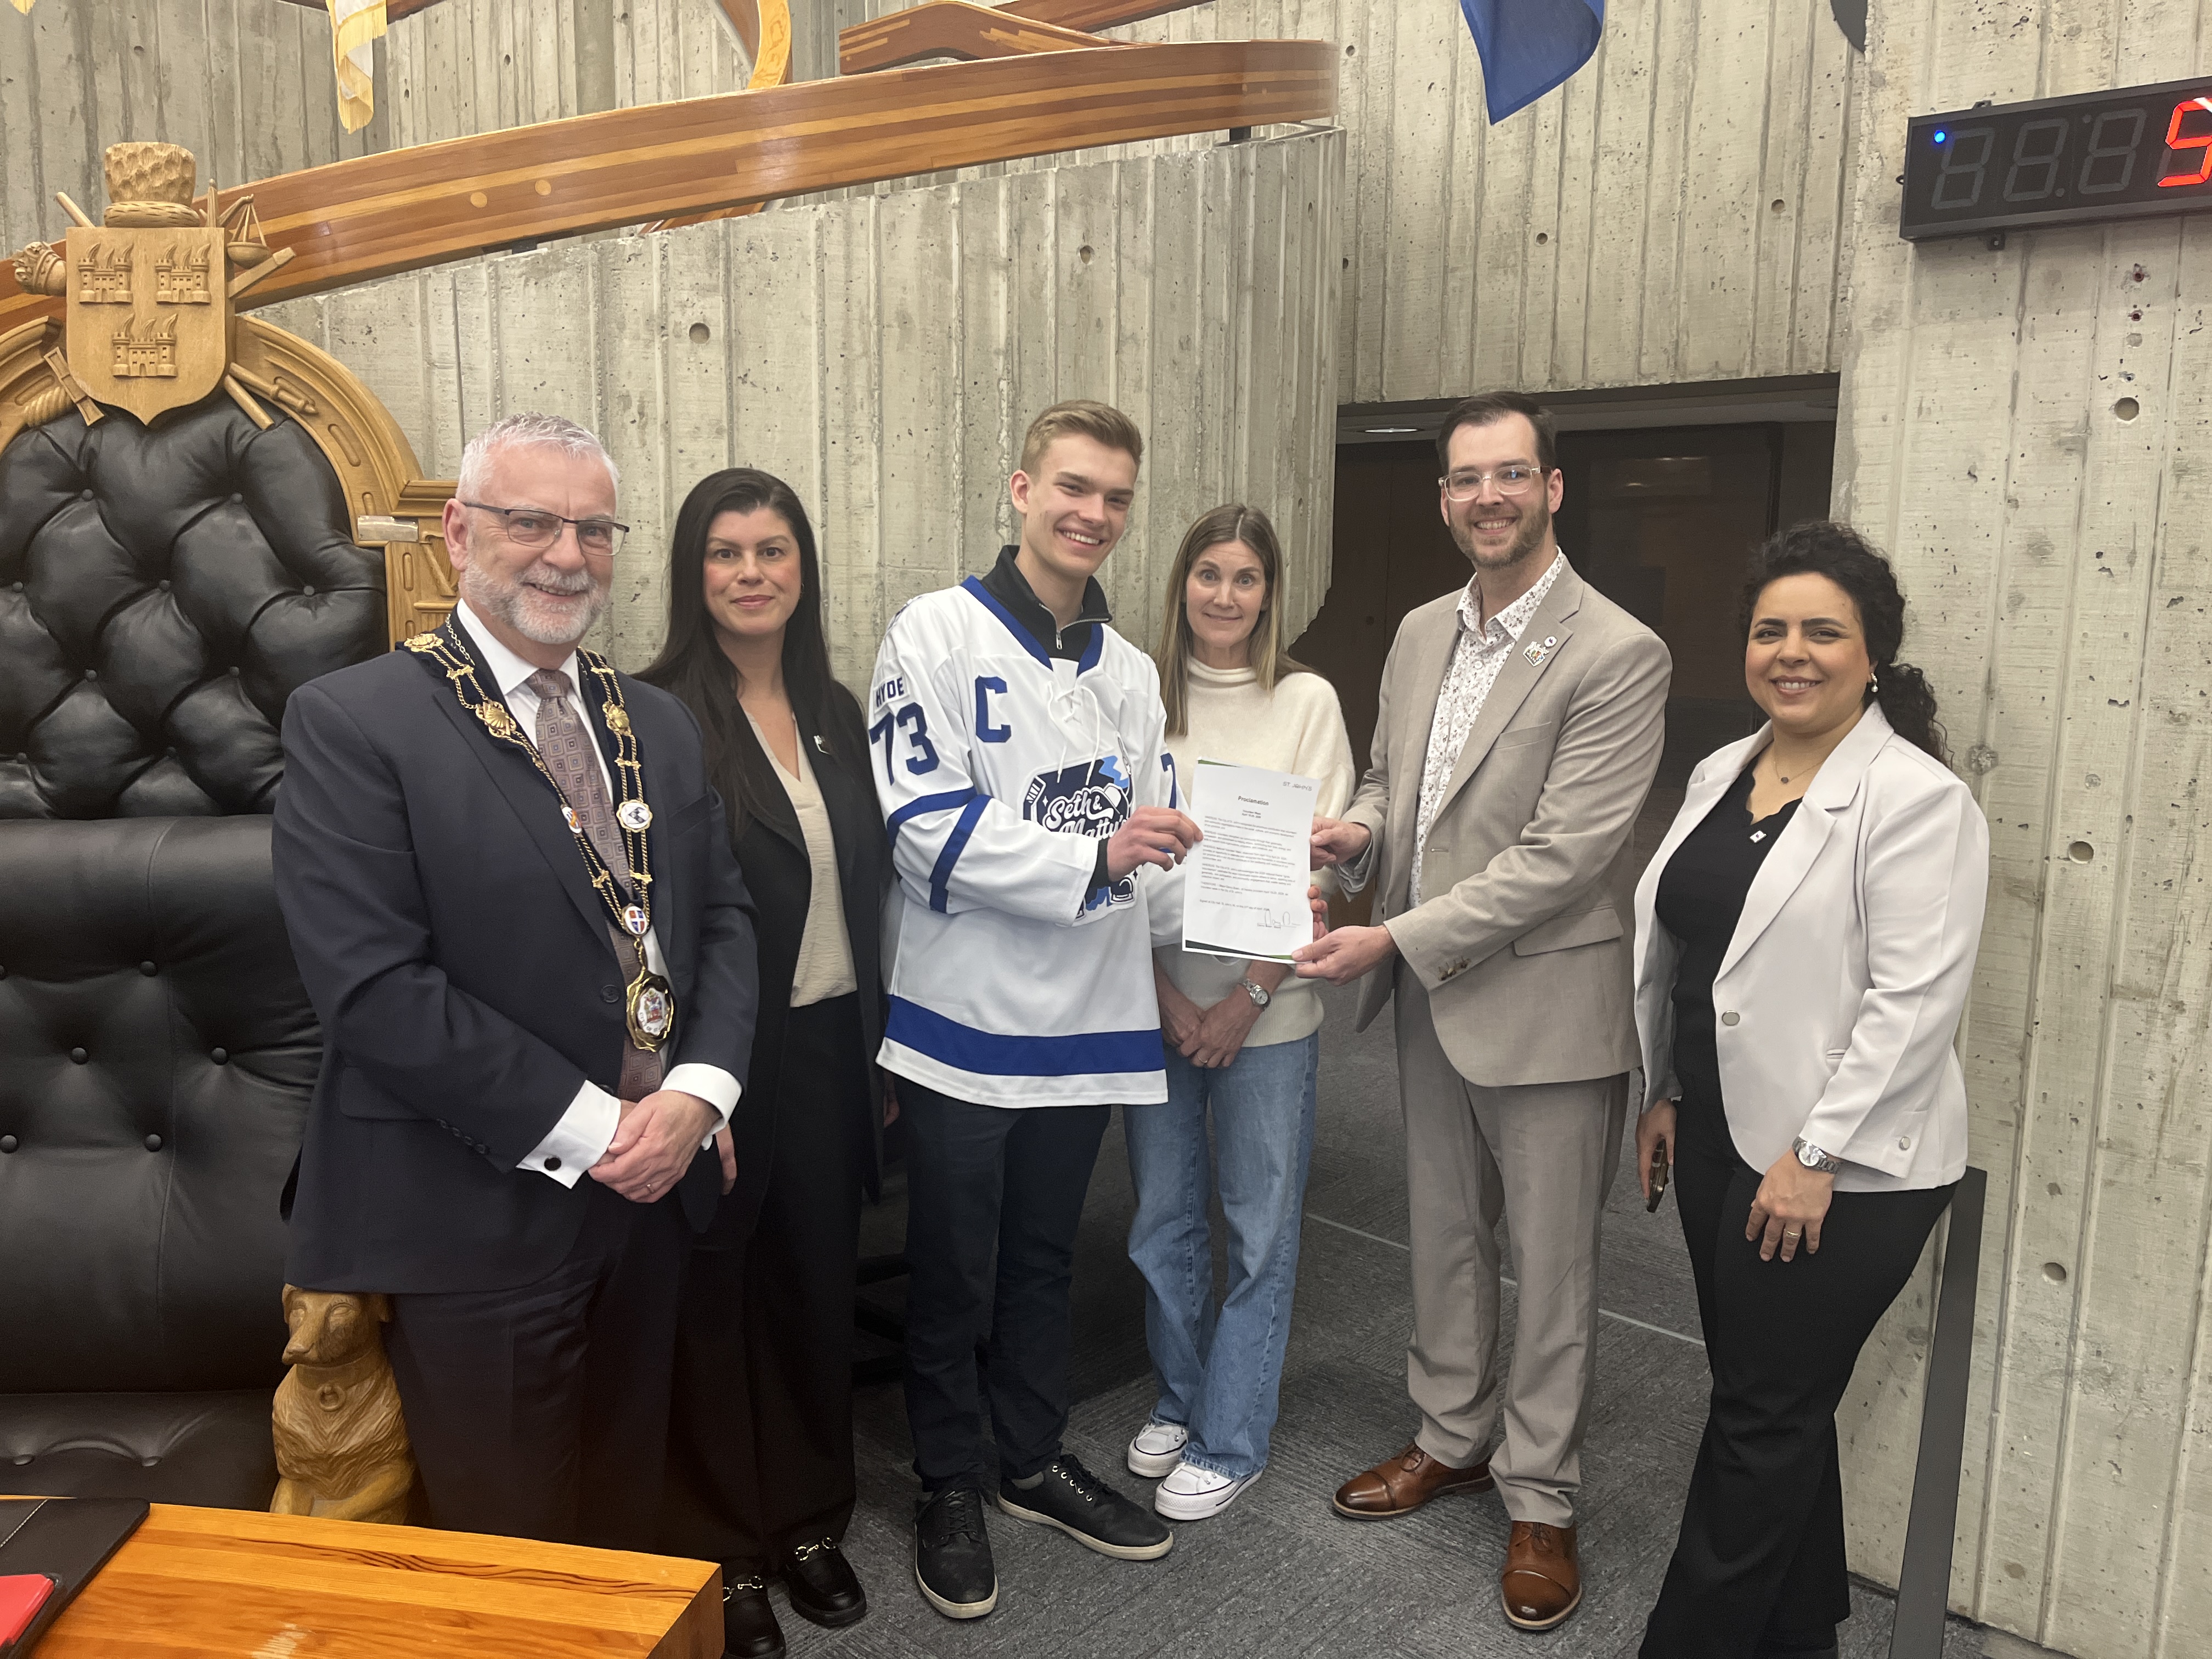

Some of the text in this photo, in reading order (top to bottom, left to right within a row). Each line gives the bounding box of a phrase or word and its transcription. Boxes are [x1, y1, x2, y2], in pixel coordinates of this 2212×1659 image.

[876, 676, 905, 708] HYDE
[975, 675, 1012, 743] C
[869, 702, 940, 786] 73
[1045, 791, 1114, 829] Seth &
[1238, 795, 1269, 806] Proclamation
